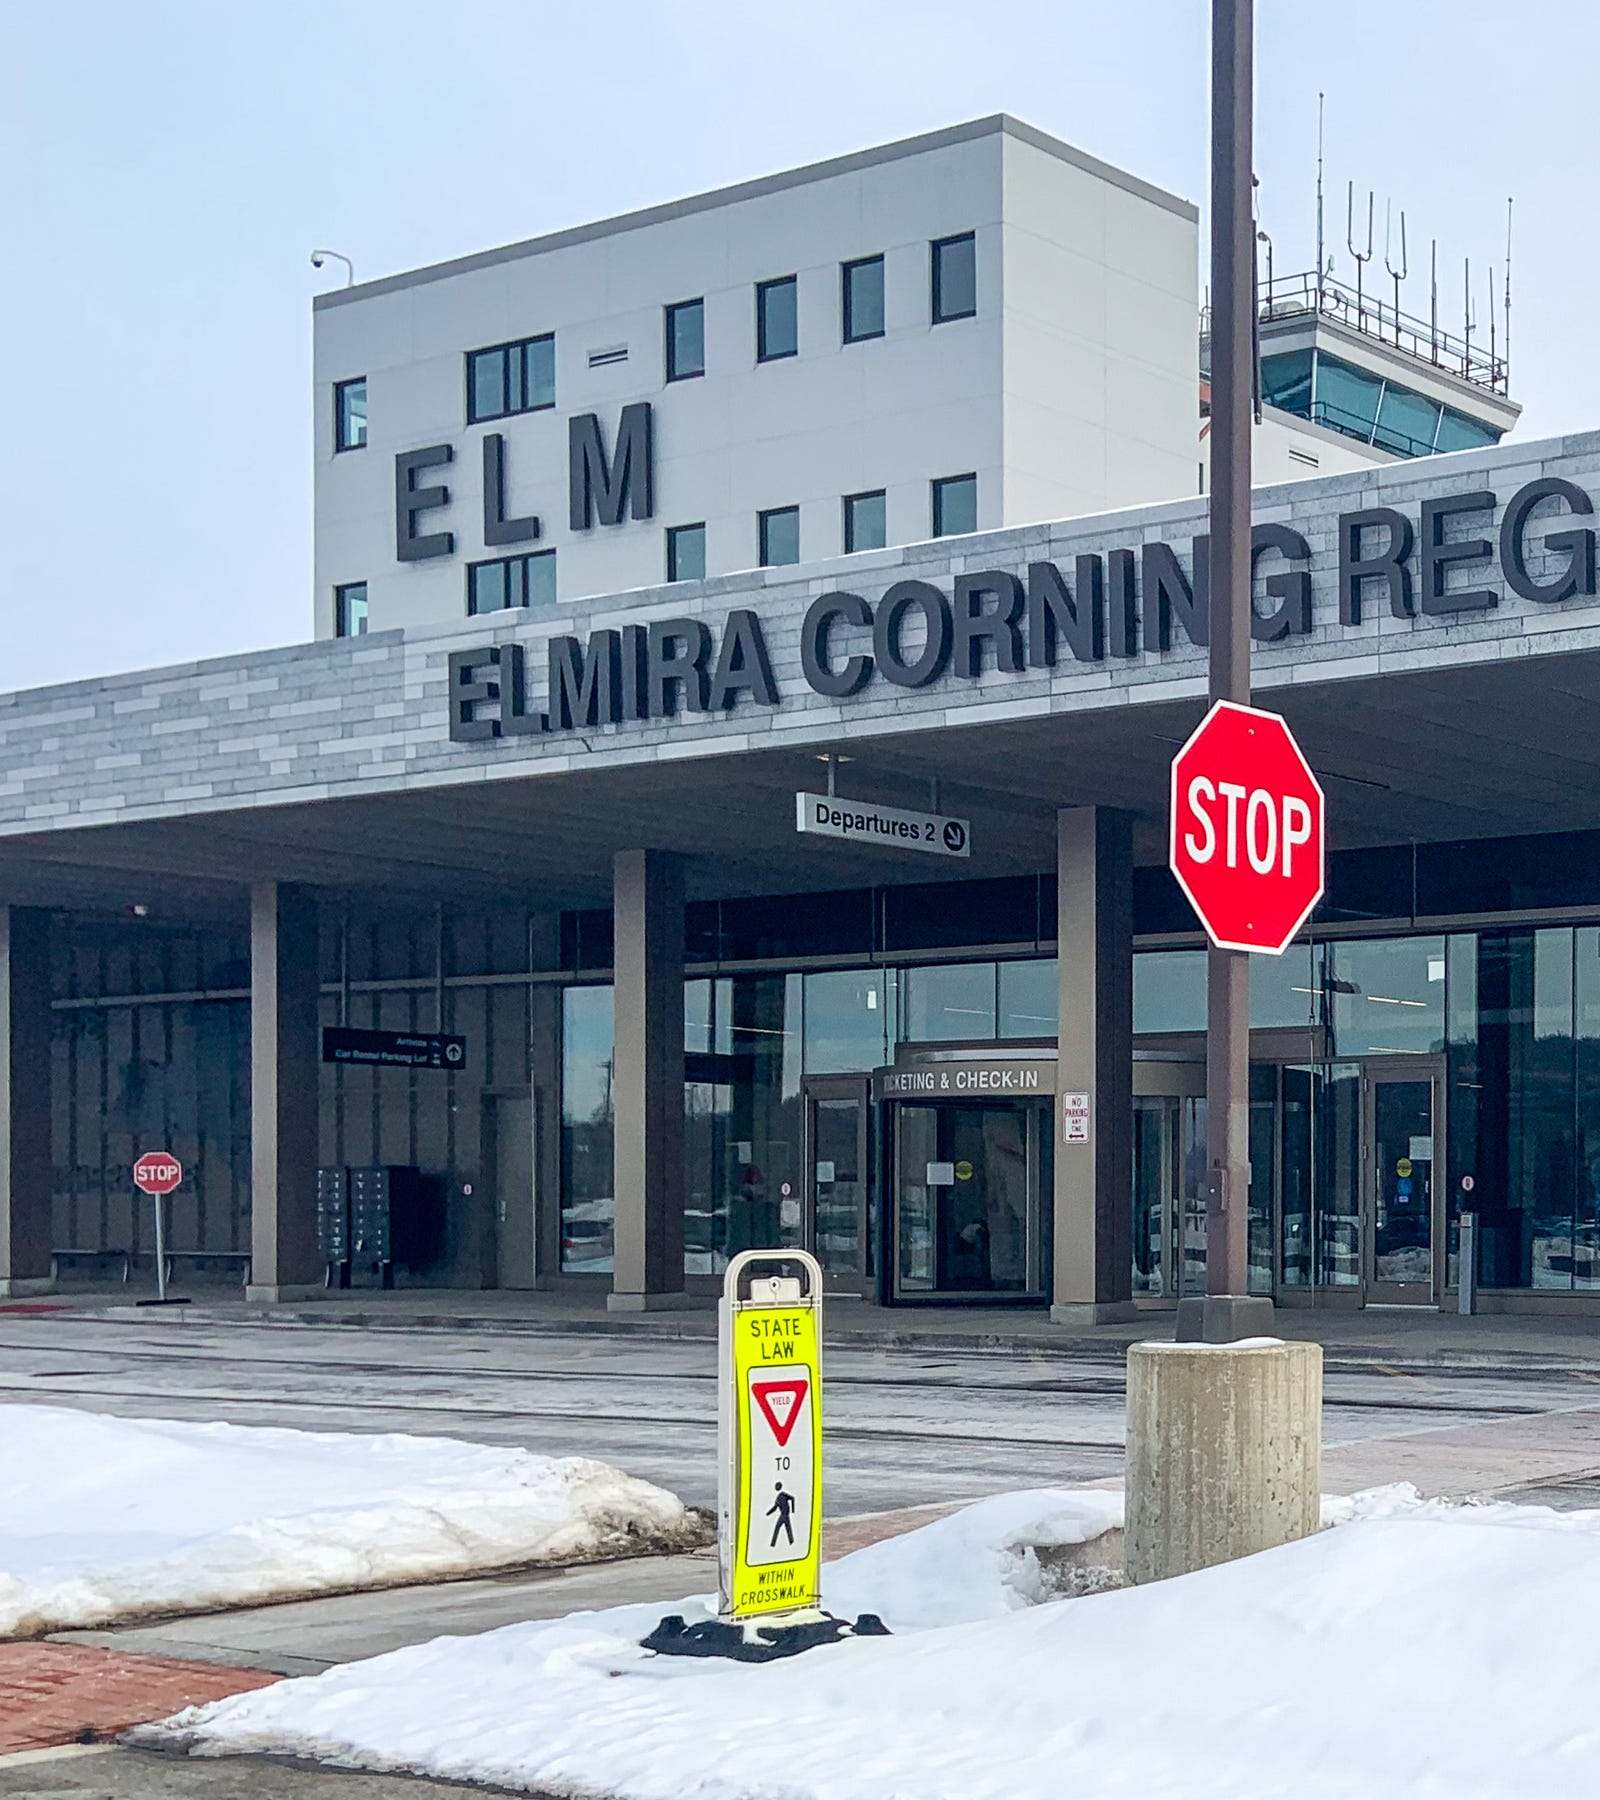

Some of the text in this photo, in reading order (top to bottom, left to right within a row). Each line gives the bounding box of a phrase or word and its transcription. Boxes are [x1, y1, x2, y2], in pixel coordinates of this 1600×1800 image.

[448, 610, 780, 742] ELMIRA
[801, 523, 1312, 697] CORNING
[816, 803, 936, 842] Departures 2
[1184, 775, 1312, 878] STOP
[940, 1072, 950, 1089] &
[956, 1070, 1038, 1089] CHECK-IN
[137, 1165, 178, 1181] STOP
[750, 1318, 801, 1338] STATE
[761, 1341, 794, 1360] LAW
[771, 1396, 791, 1406] YIELD
[775, 1456, 791, 1471] TO
[758, 1567, 795, 1585] WITHIN
[741, 1583, 805, 1606] CROSSWALK
